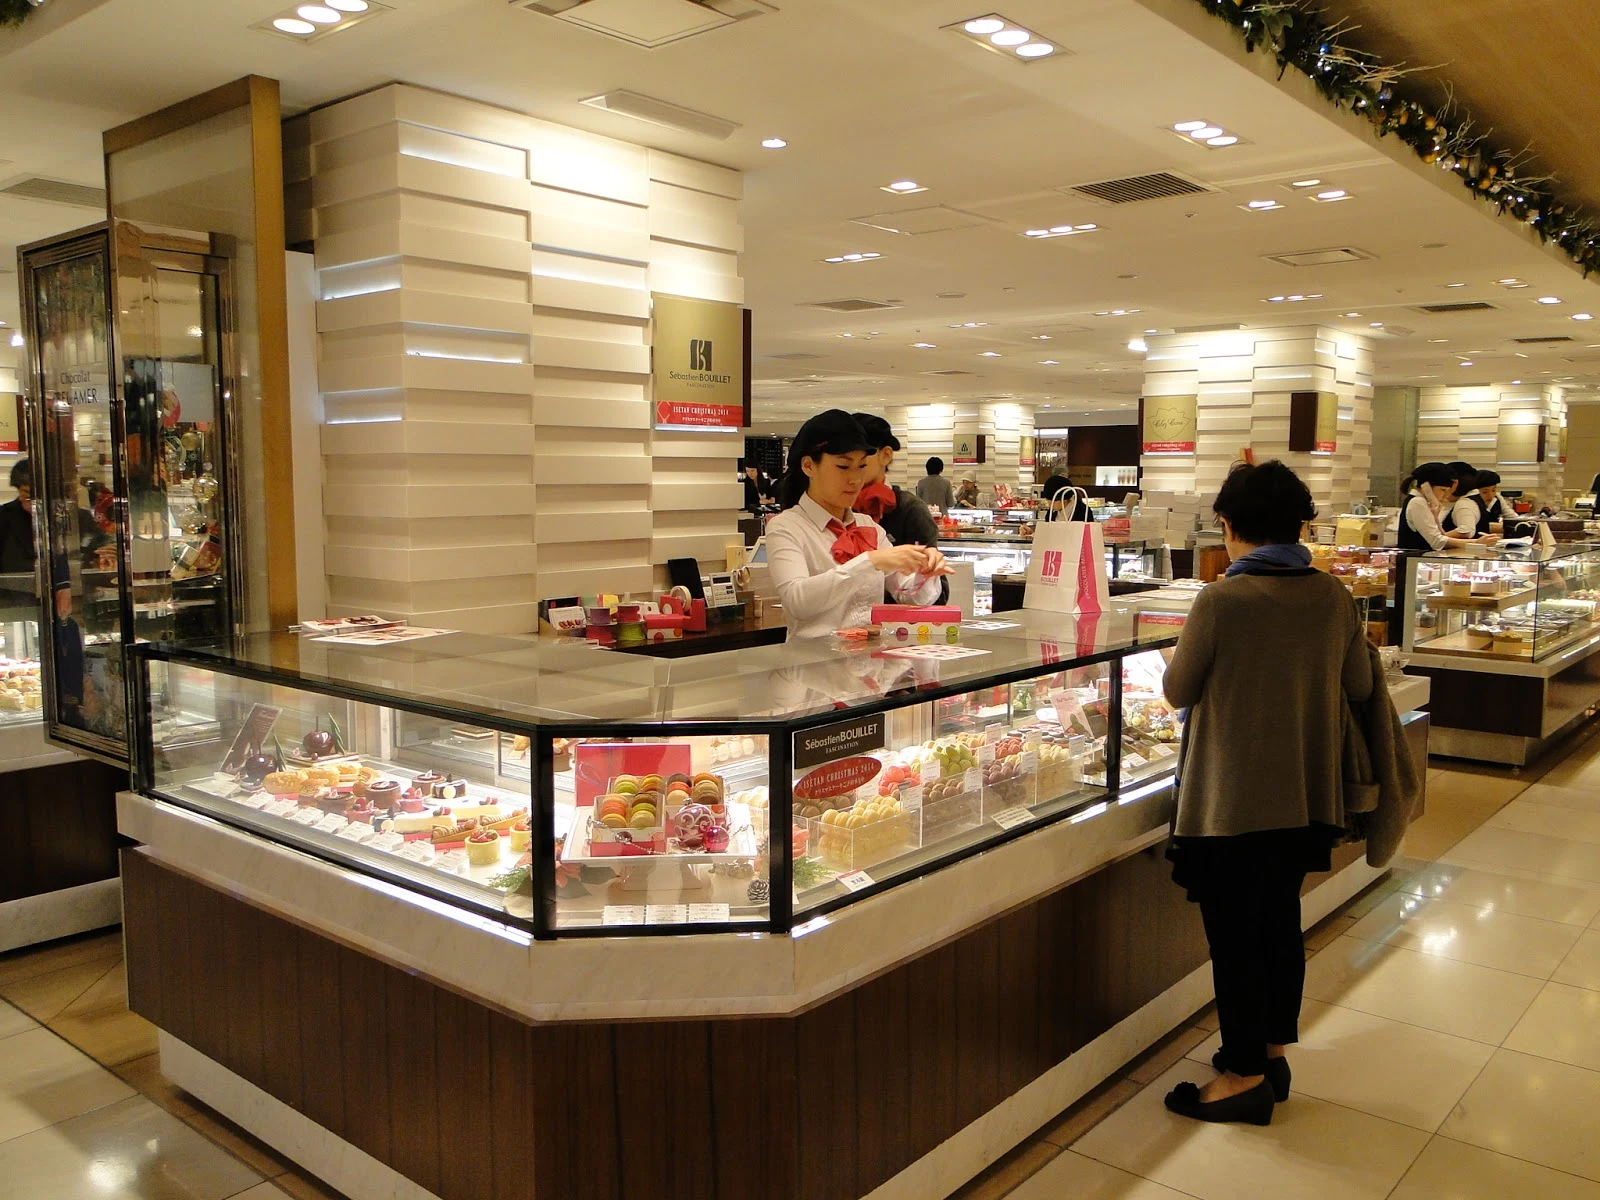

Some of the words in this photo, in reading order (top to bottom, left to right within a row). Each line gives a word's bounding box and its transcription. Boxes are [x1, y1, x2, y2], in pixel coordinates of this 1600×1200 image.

[61, 370, 91, 384] Chocolat
[74, 388, 98, 404] AMER
[673, 406, 690, 414] ISETAN
[691, 407, 716, 415] CHRISTMAS
[825, 741, 859, 754] FASCINATION
[803, 774, 824, 789] ISETAN
[826, 767, 859, 782] CHRISTMAS
